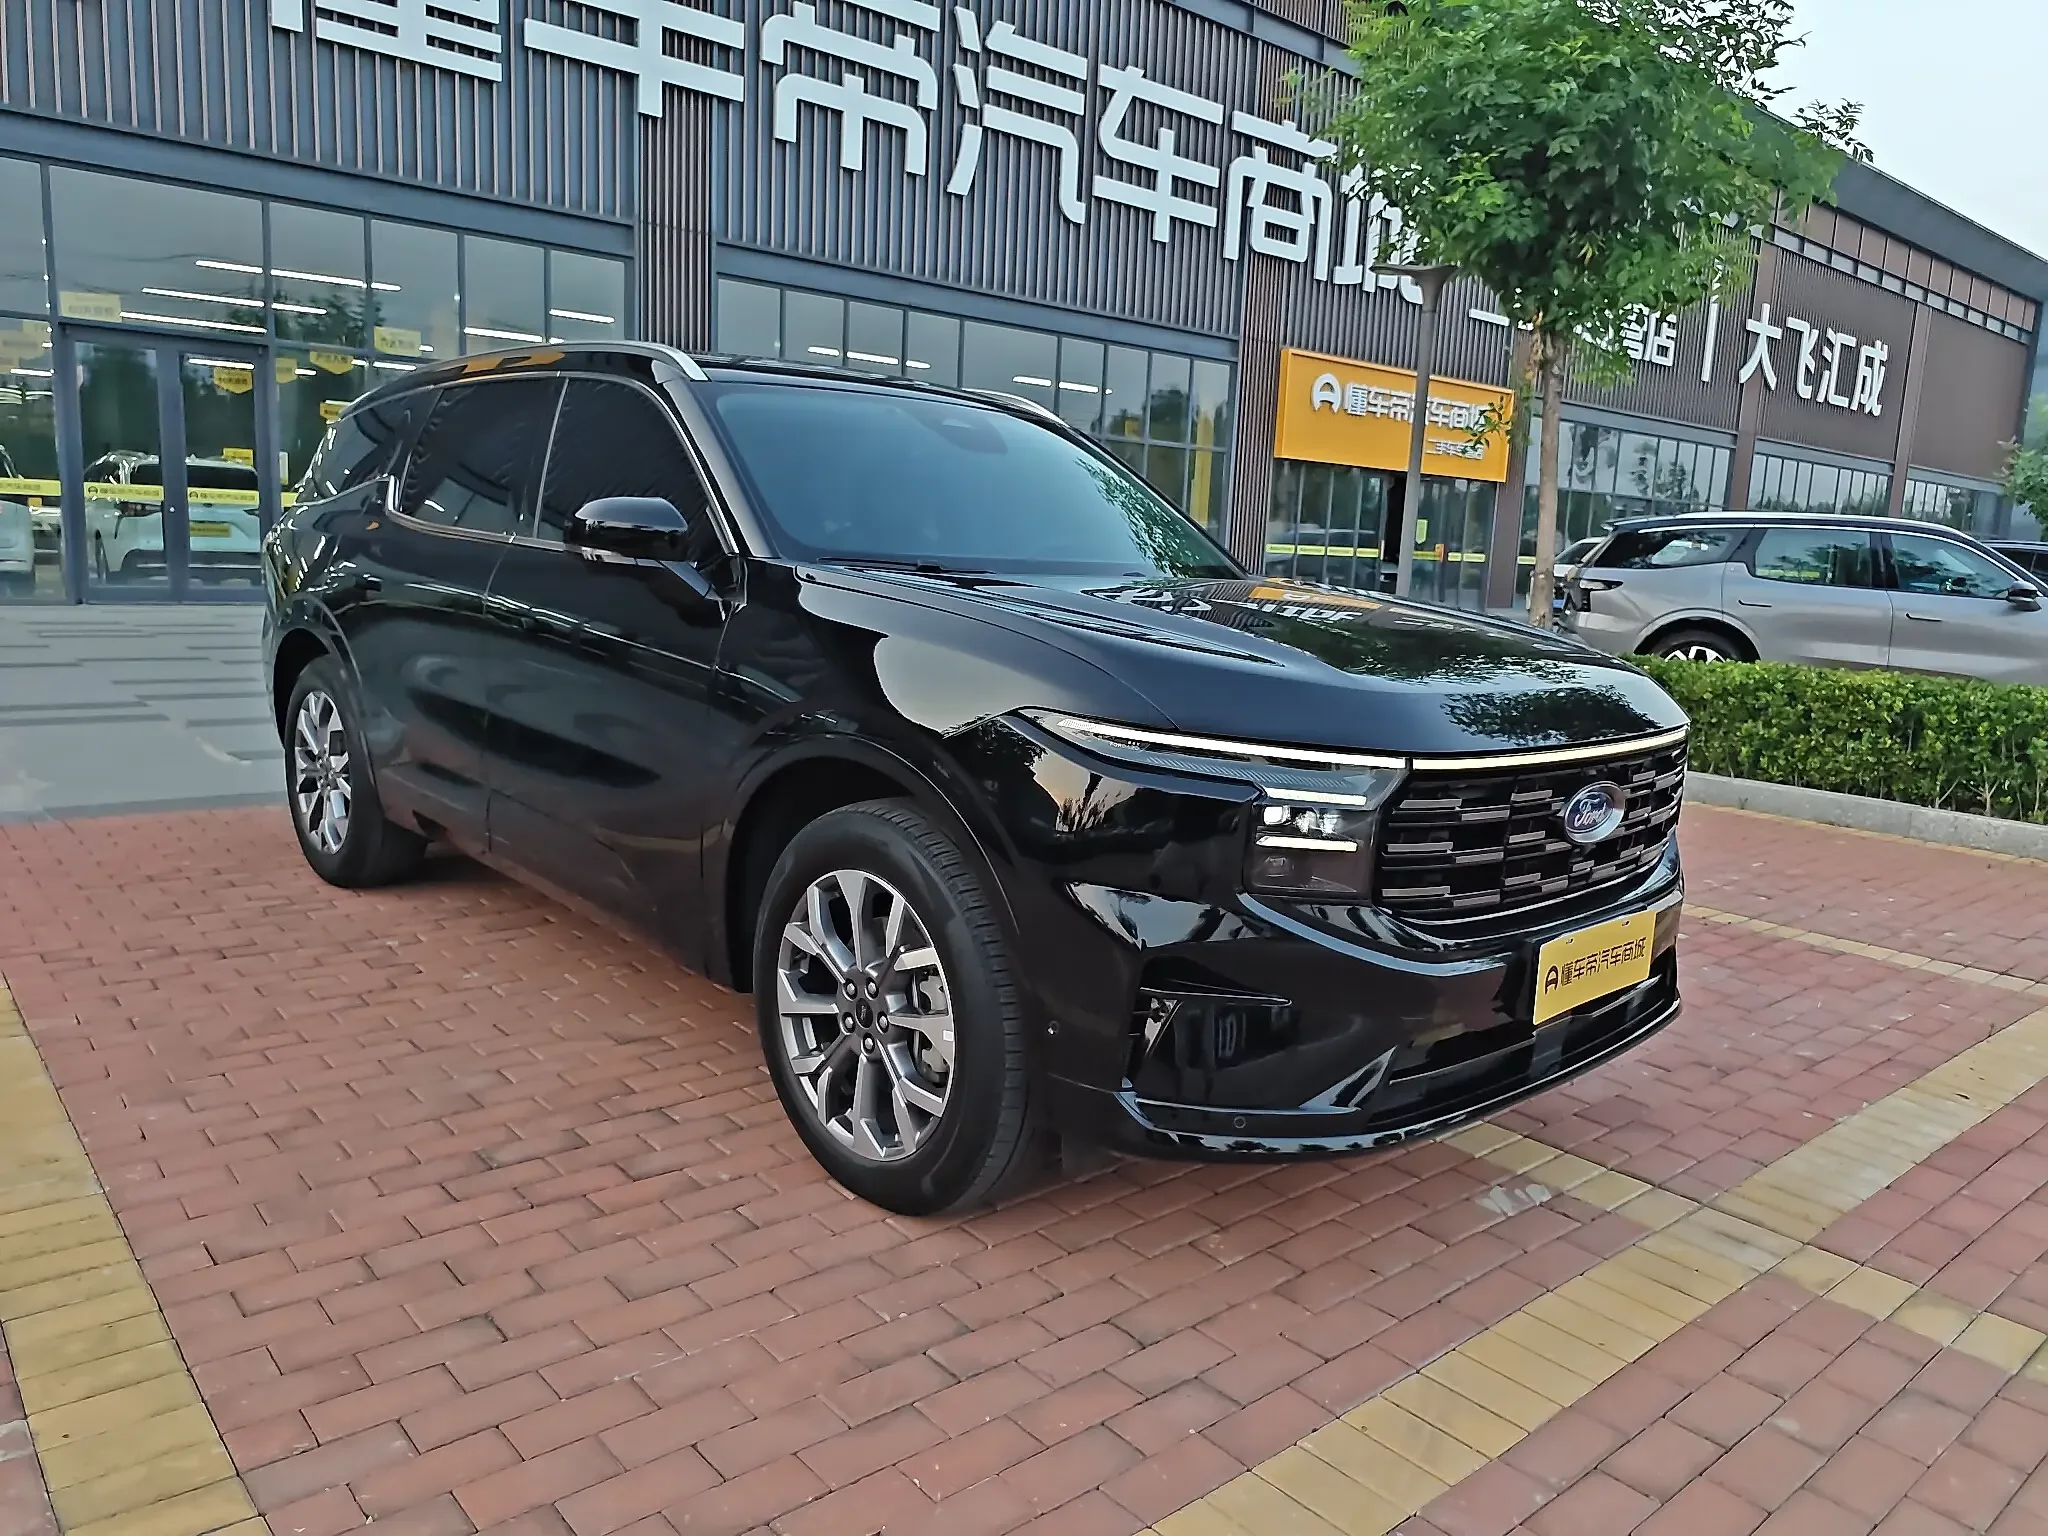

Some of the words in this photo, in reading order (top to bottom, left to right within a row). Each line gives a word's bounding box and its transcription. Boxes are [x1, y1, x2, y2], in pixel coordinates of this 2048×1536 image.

[1739, 303, 1888, 417] 大飞汇成
[1574, 798, 1607, 827] Ford
[1561, 937, 1646, 986] 懂车帝汽车商城
